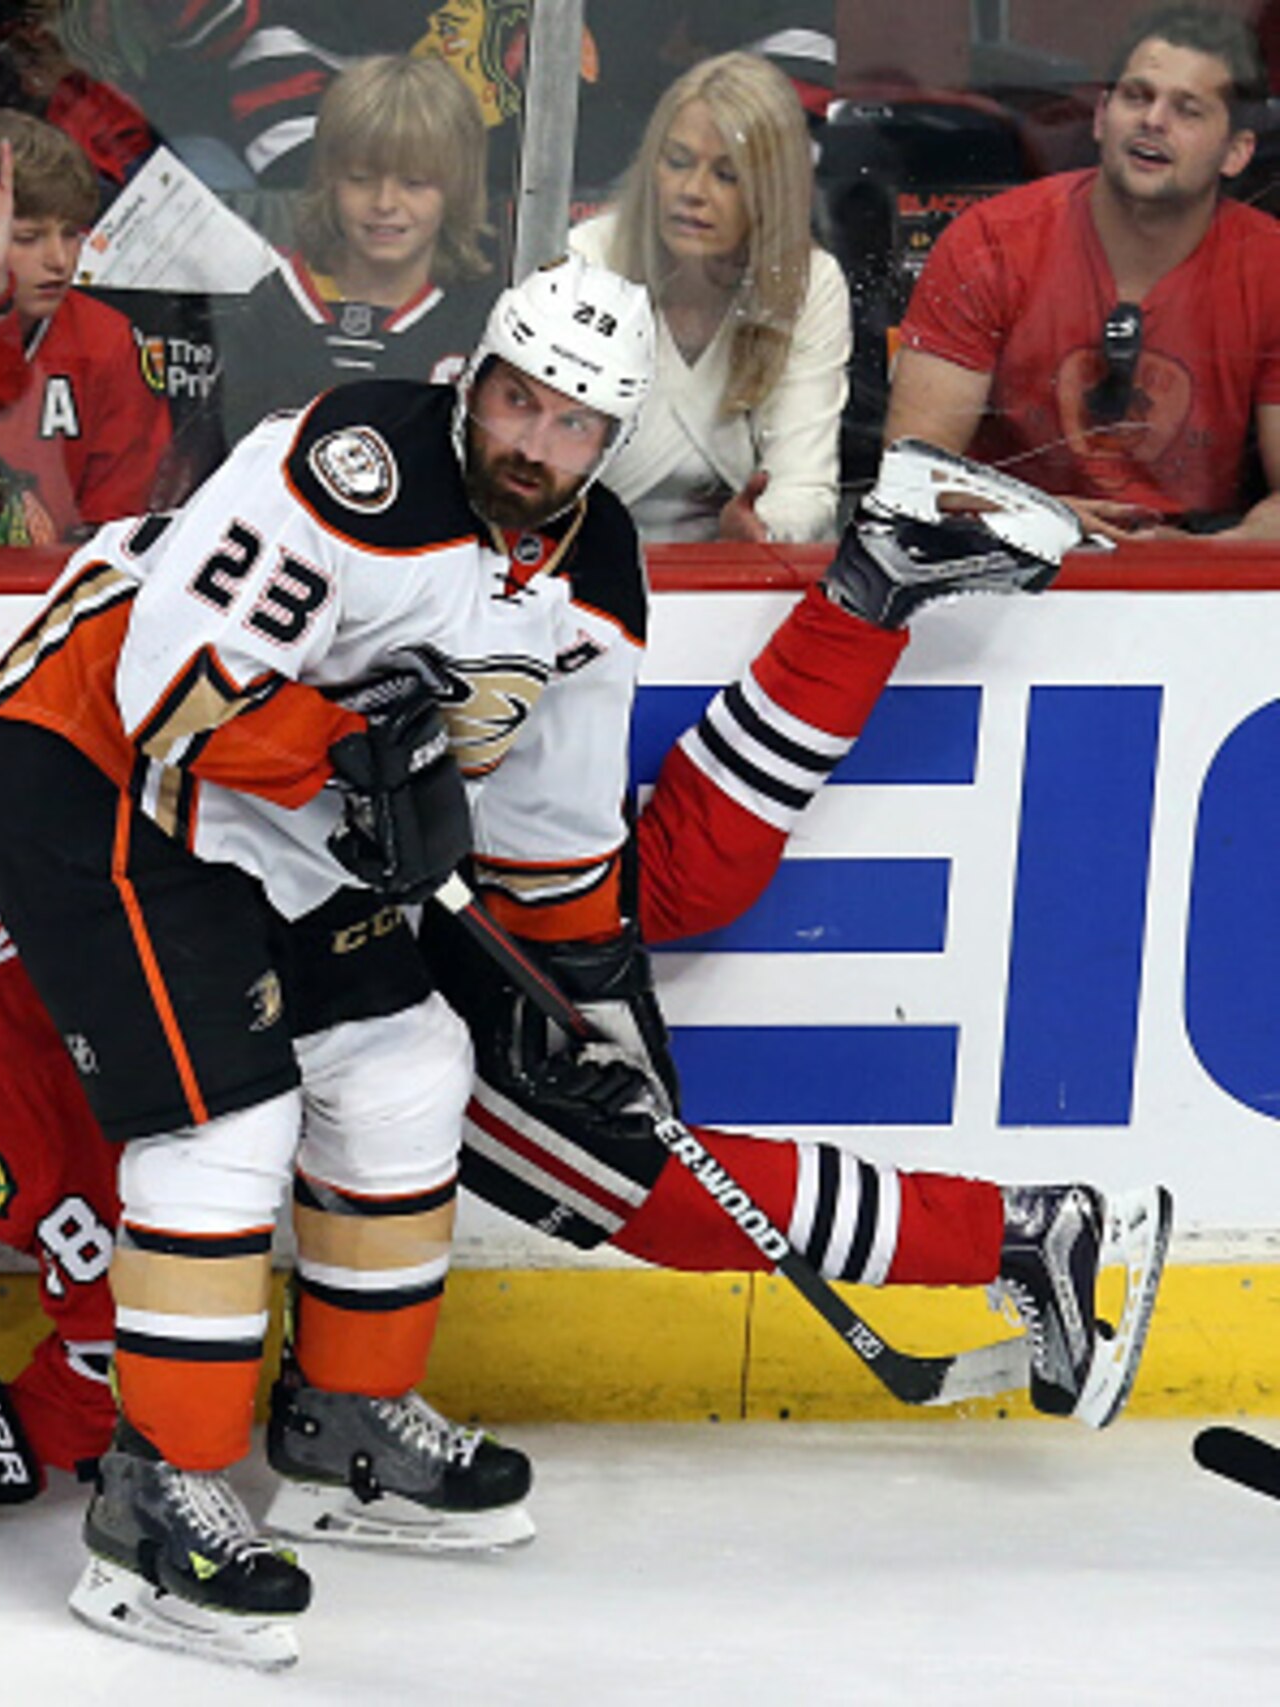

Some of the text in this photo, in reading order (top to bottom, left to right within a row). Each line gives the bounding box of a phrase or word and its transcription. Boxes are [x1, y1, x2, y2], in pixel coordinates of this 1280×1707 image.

[167, 337, 214, 363] The
[39, 374, 81, 440] A
[185, 514, 338, 652] 23
[332, 904, 404, 954] CC
